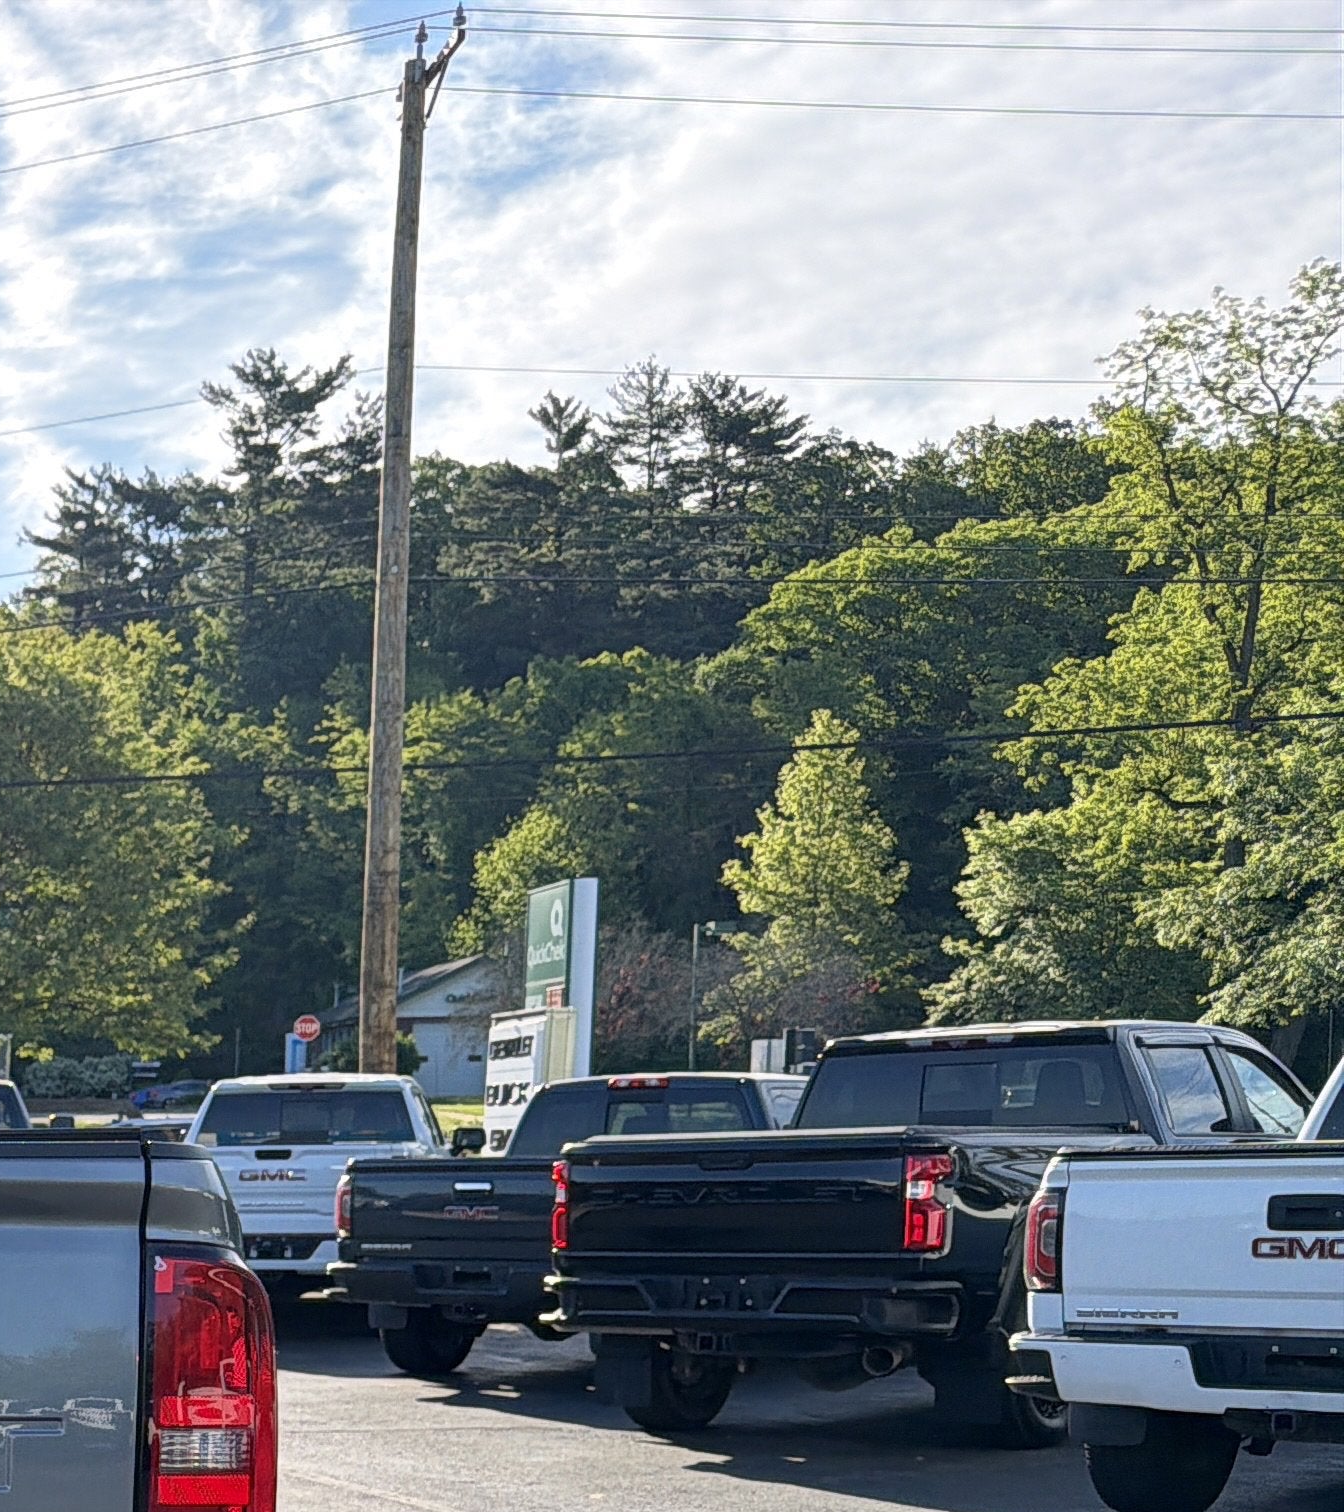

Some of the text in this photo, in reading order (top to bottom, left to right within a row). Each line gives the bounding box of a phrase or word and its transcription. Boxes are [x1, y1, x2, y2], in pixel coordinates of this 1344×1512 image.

[295, 1021, 319, 1034] STOP
[238, 1168, 307, 1182] GMC
[443, 1205, 500, 1221] GMC
